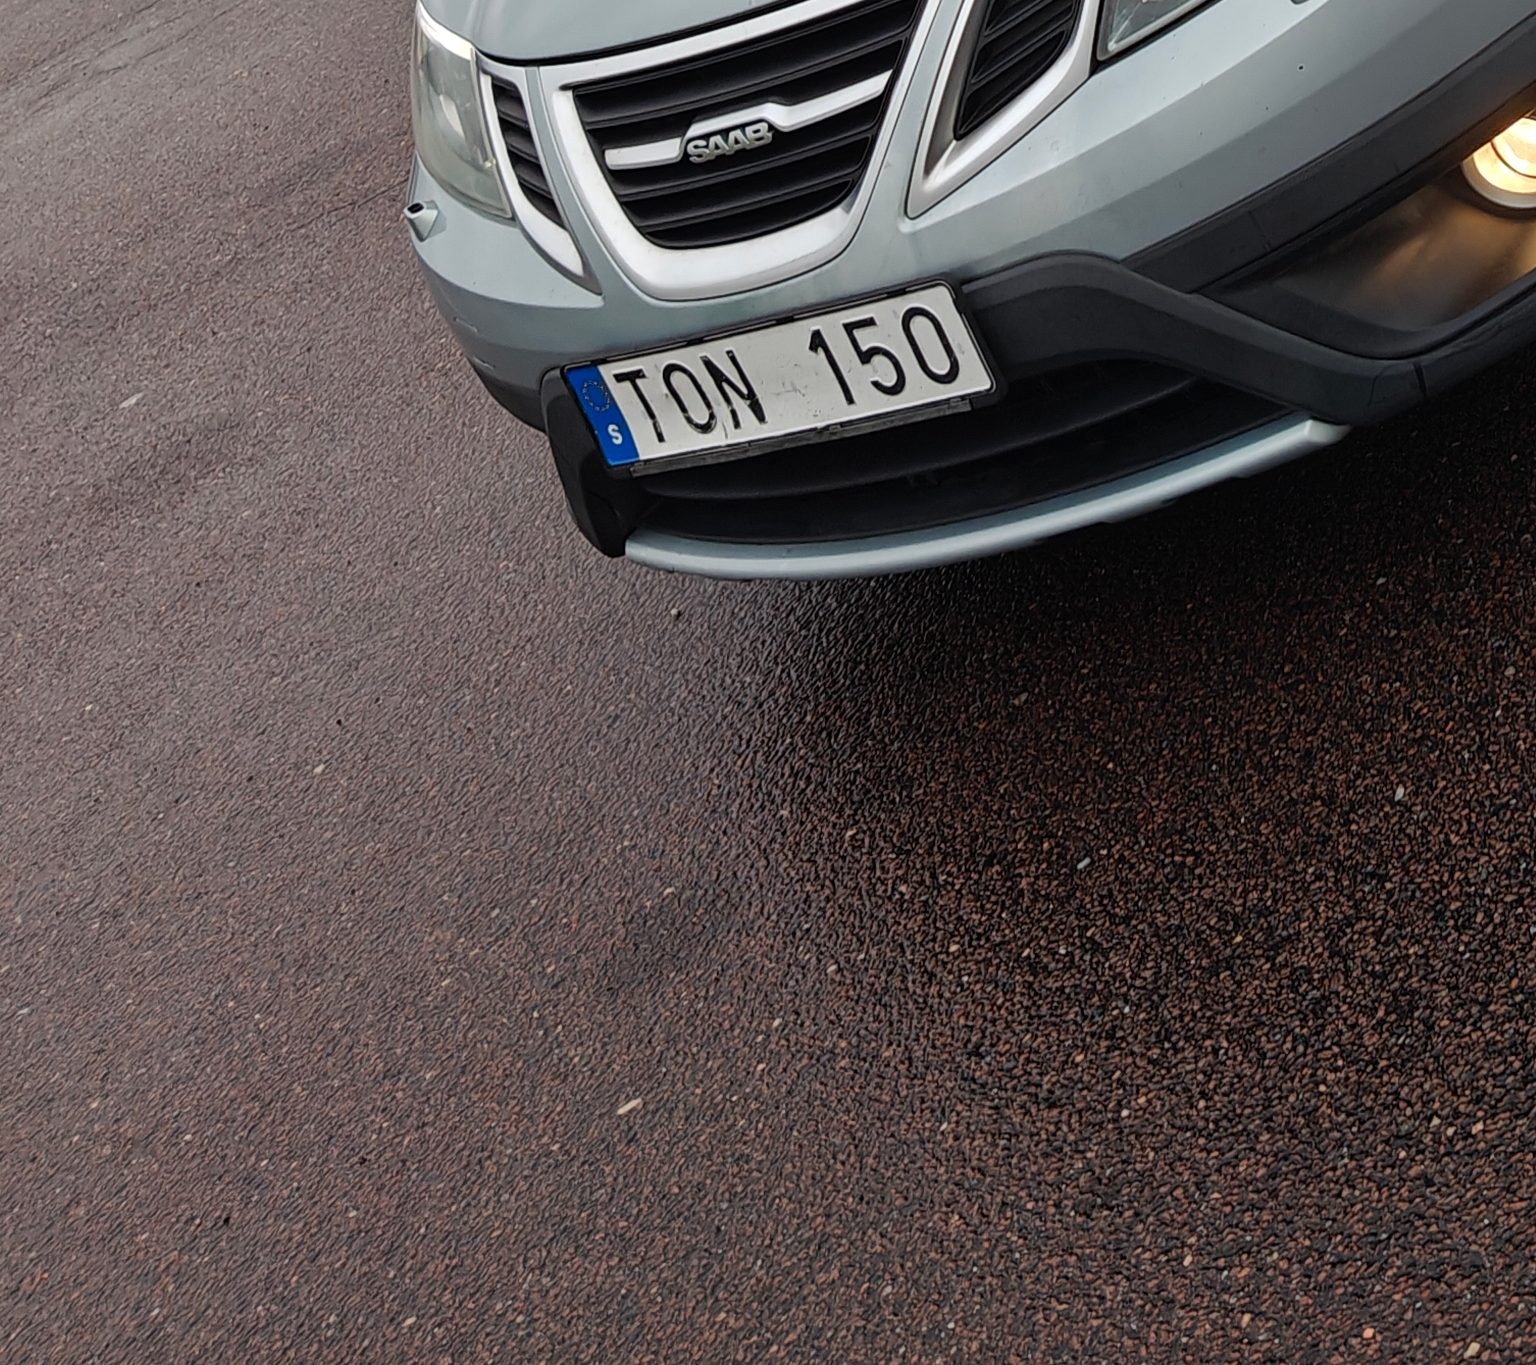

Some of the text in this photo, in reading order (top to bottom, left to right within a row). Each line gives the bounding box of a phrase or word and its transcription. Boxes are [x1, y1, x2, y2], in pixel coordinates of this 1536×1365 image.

[686, 121, 773, 164] SAAB
[607, 305, 960, 446] S TON 150
